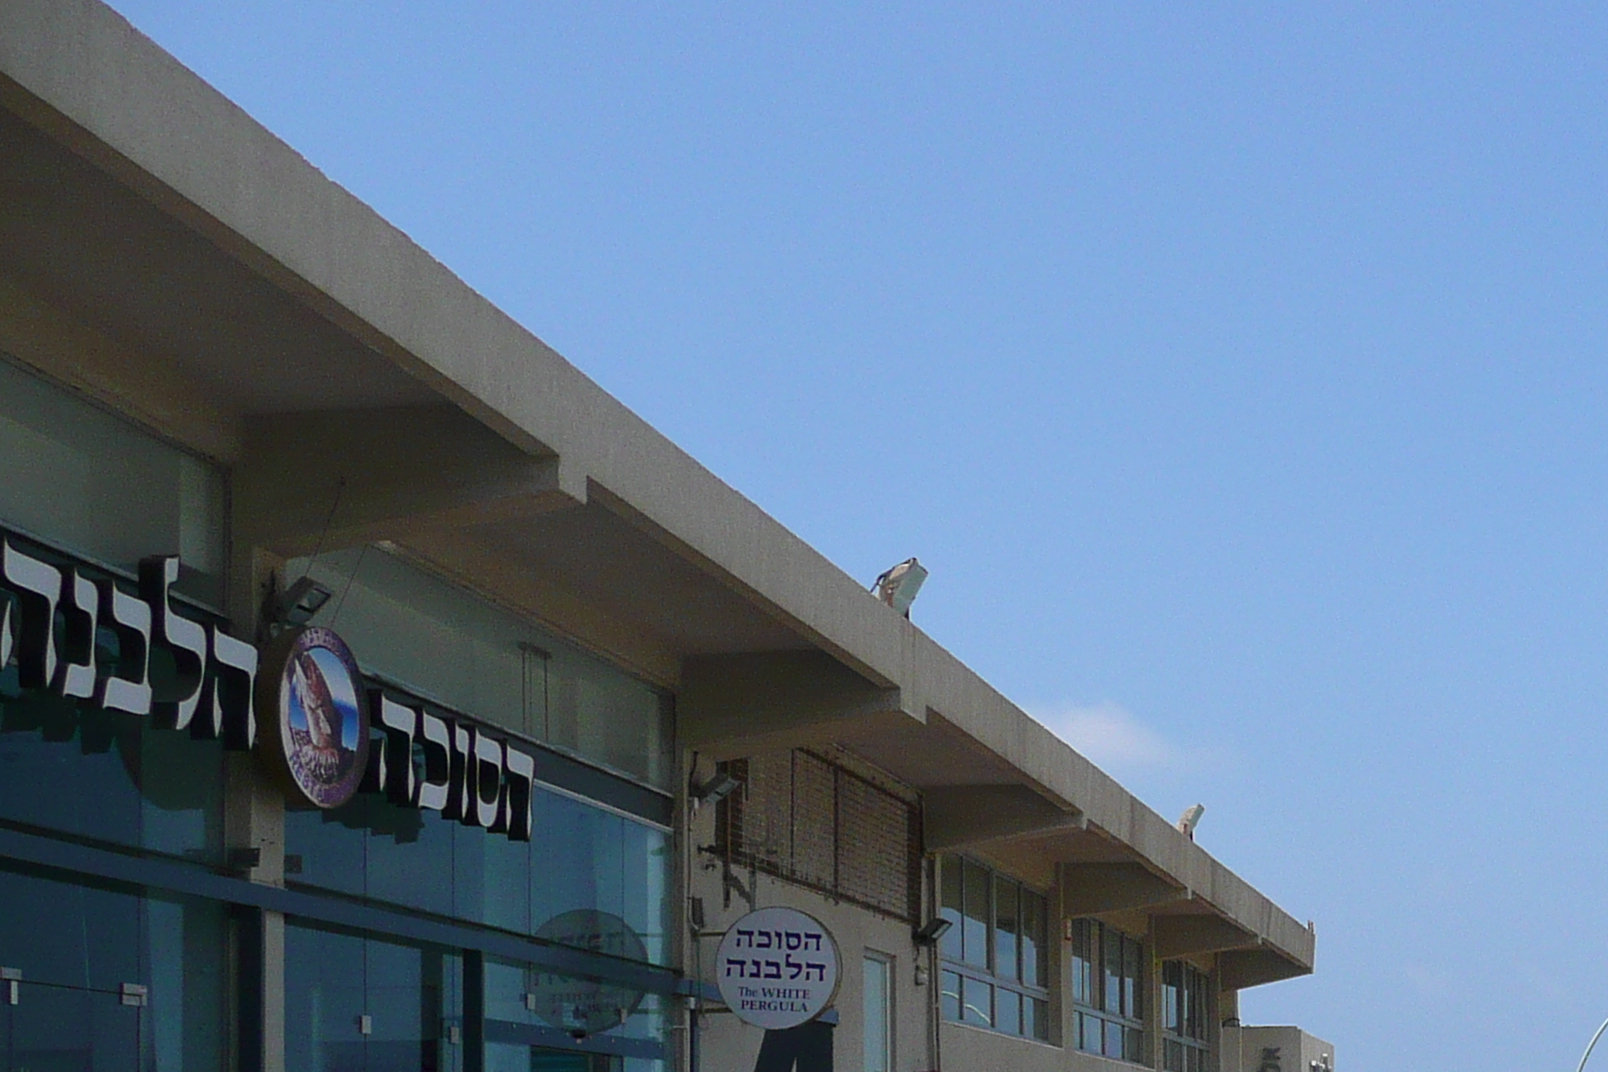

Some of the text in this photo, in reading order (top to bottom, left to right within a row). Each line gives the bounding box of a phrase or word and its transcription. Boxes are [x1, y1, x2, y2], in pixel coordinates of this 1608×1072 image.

[0, 538, 259, 750] הלבנה
[372, 691, 535, 841] הסוכה
[736, 929, 822, 951] הסוכה
[726, 953, 826, 981] הלבנה
[738, 986, 811, 1000] The WHITE
[741, 999, 808, 1013] PERGULA
